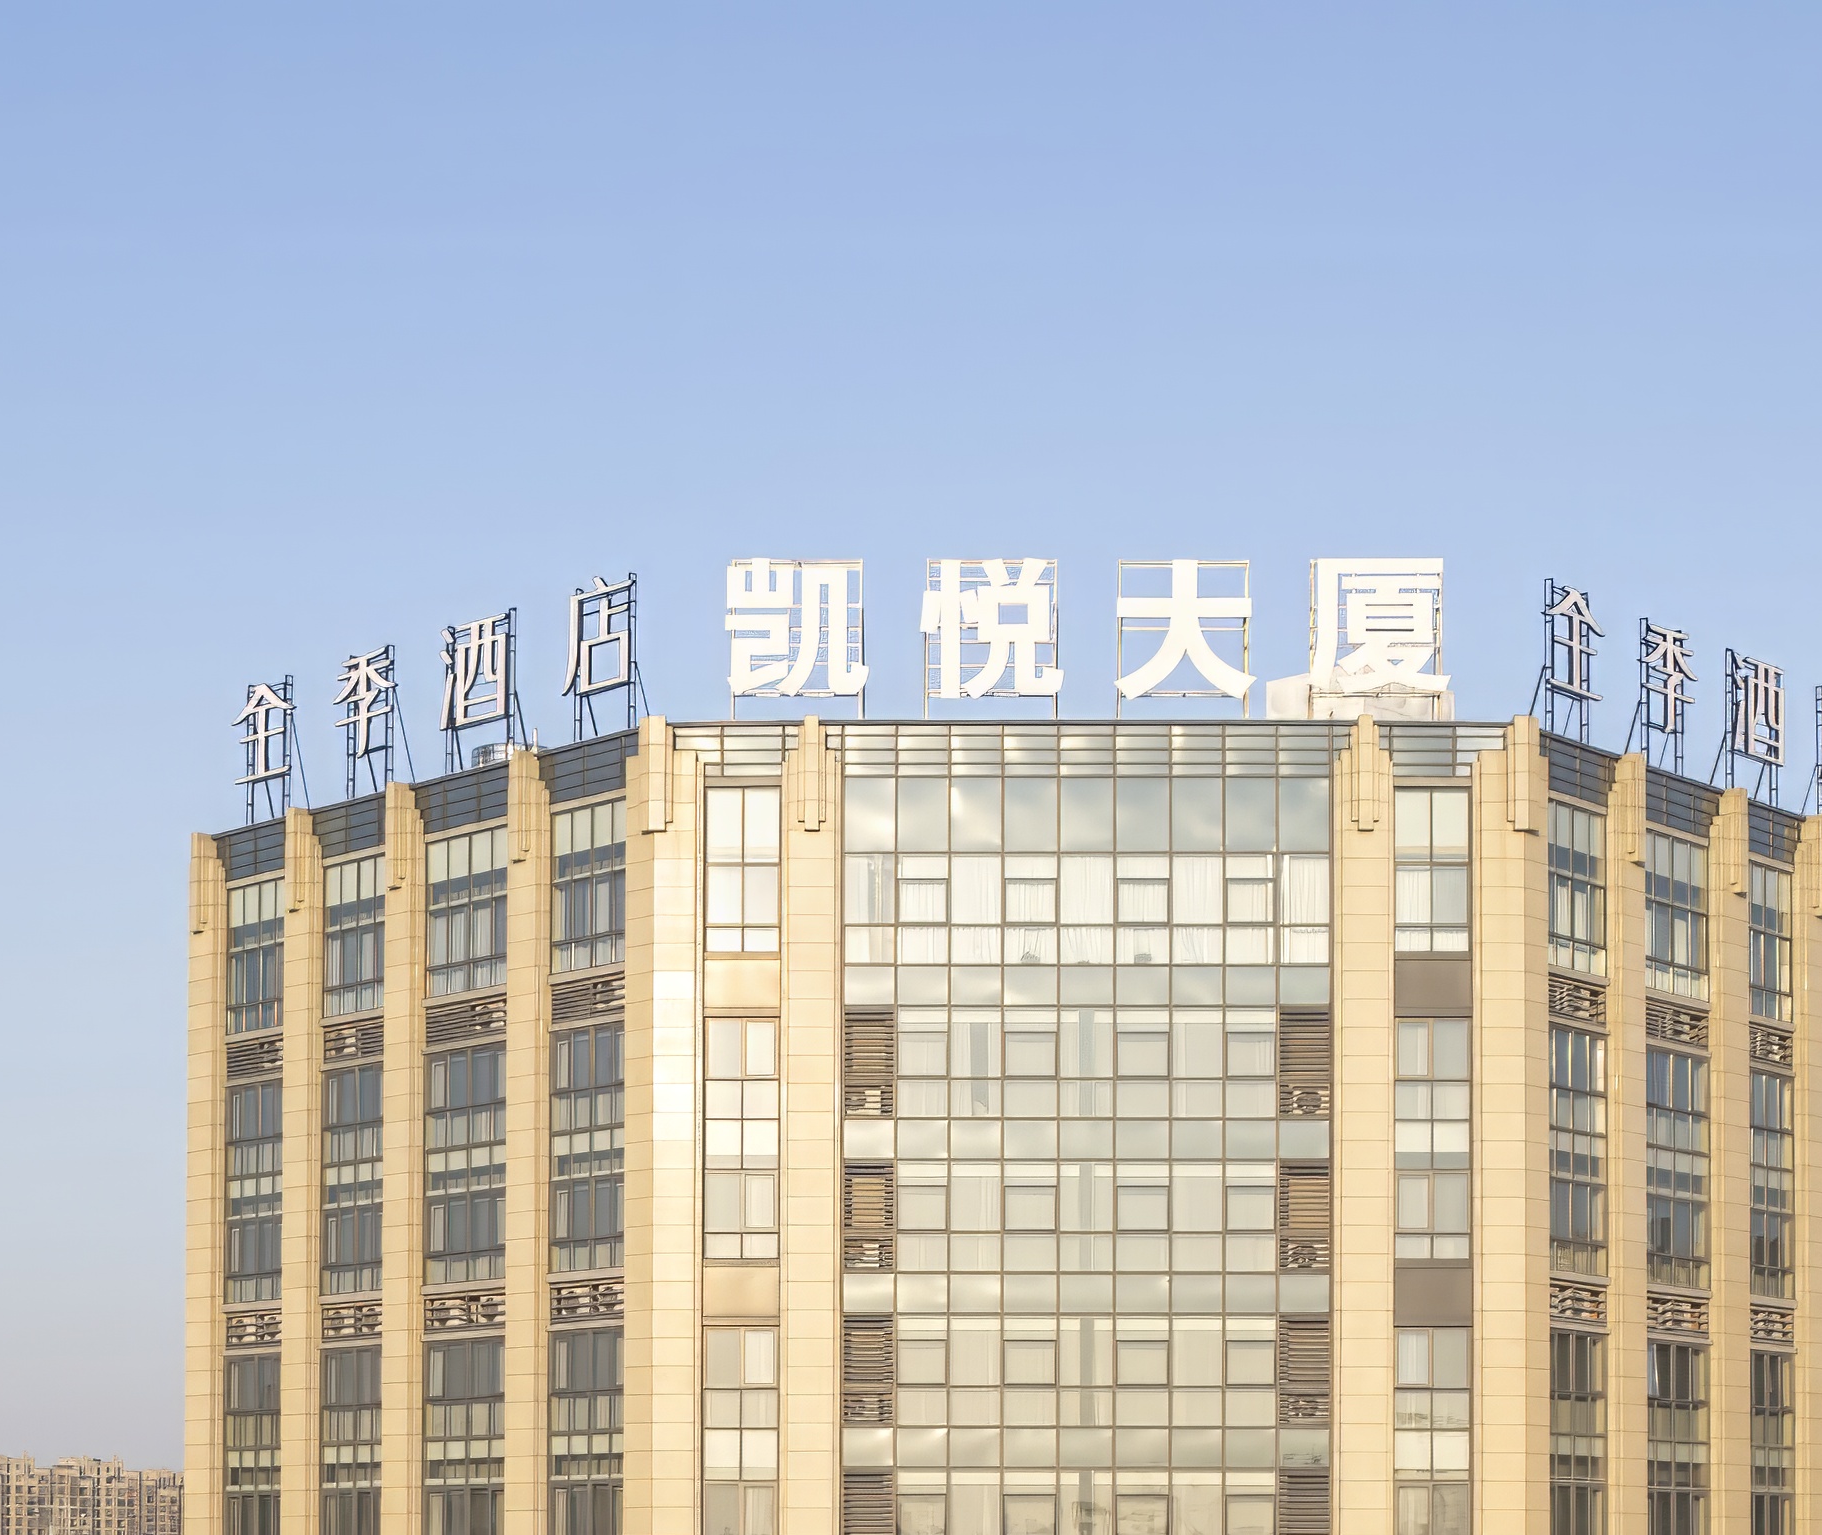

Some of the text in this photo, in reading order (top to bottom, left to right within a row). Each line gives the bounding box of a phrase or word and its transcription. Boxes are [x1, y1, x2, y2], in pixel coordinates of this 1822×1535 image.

[232, 576, 635, 785] 全季酒店
[726, 558, 1450, 699] 凯悦大厦
